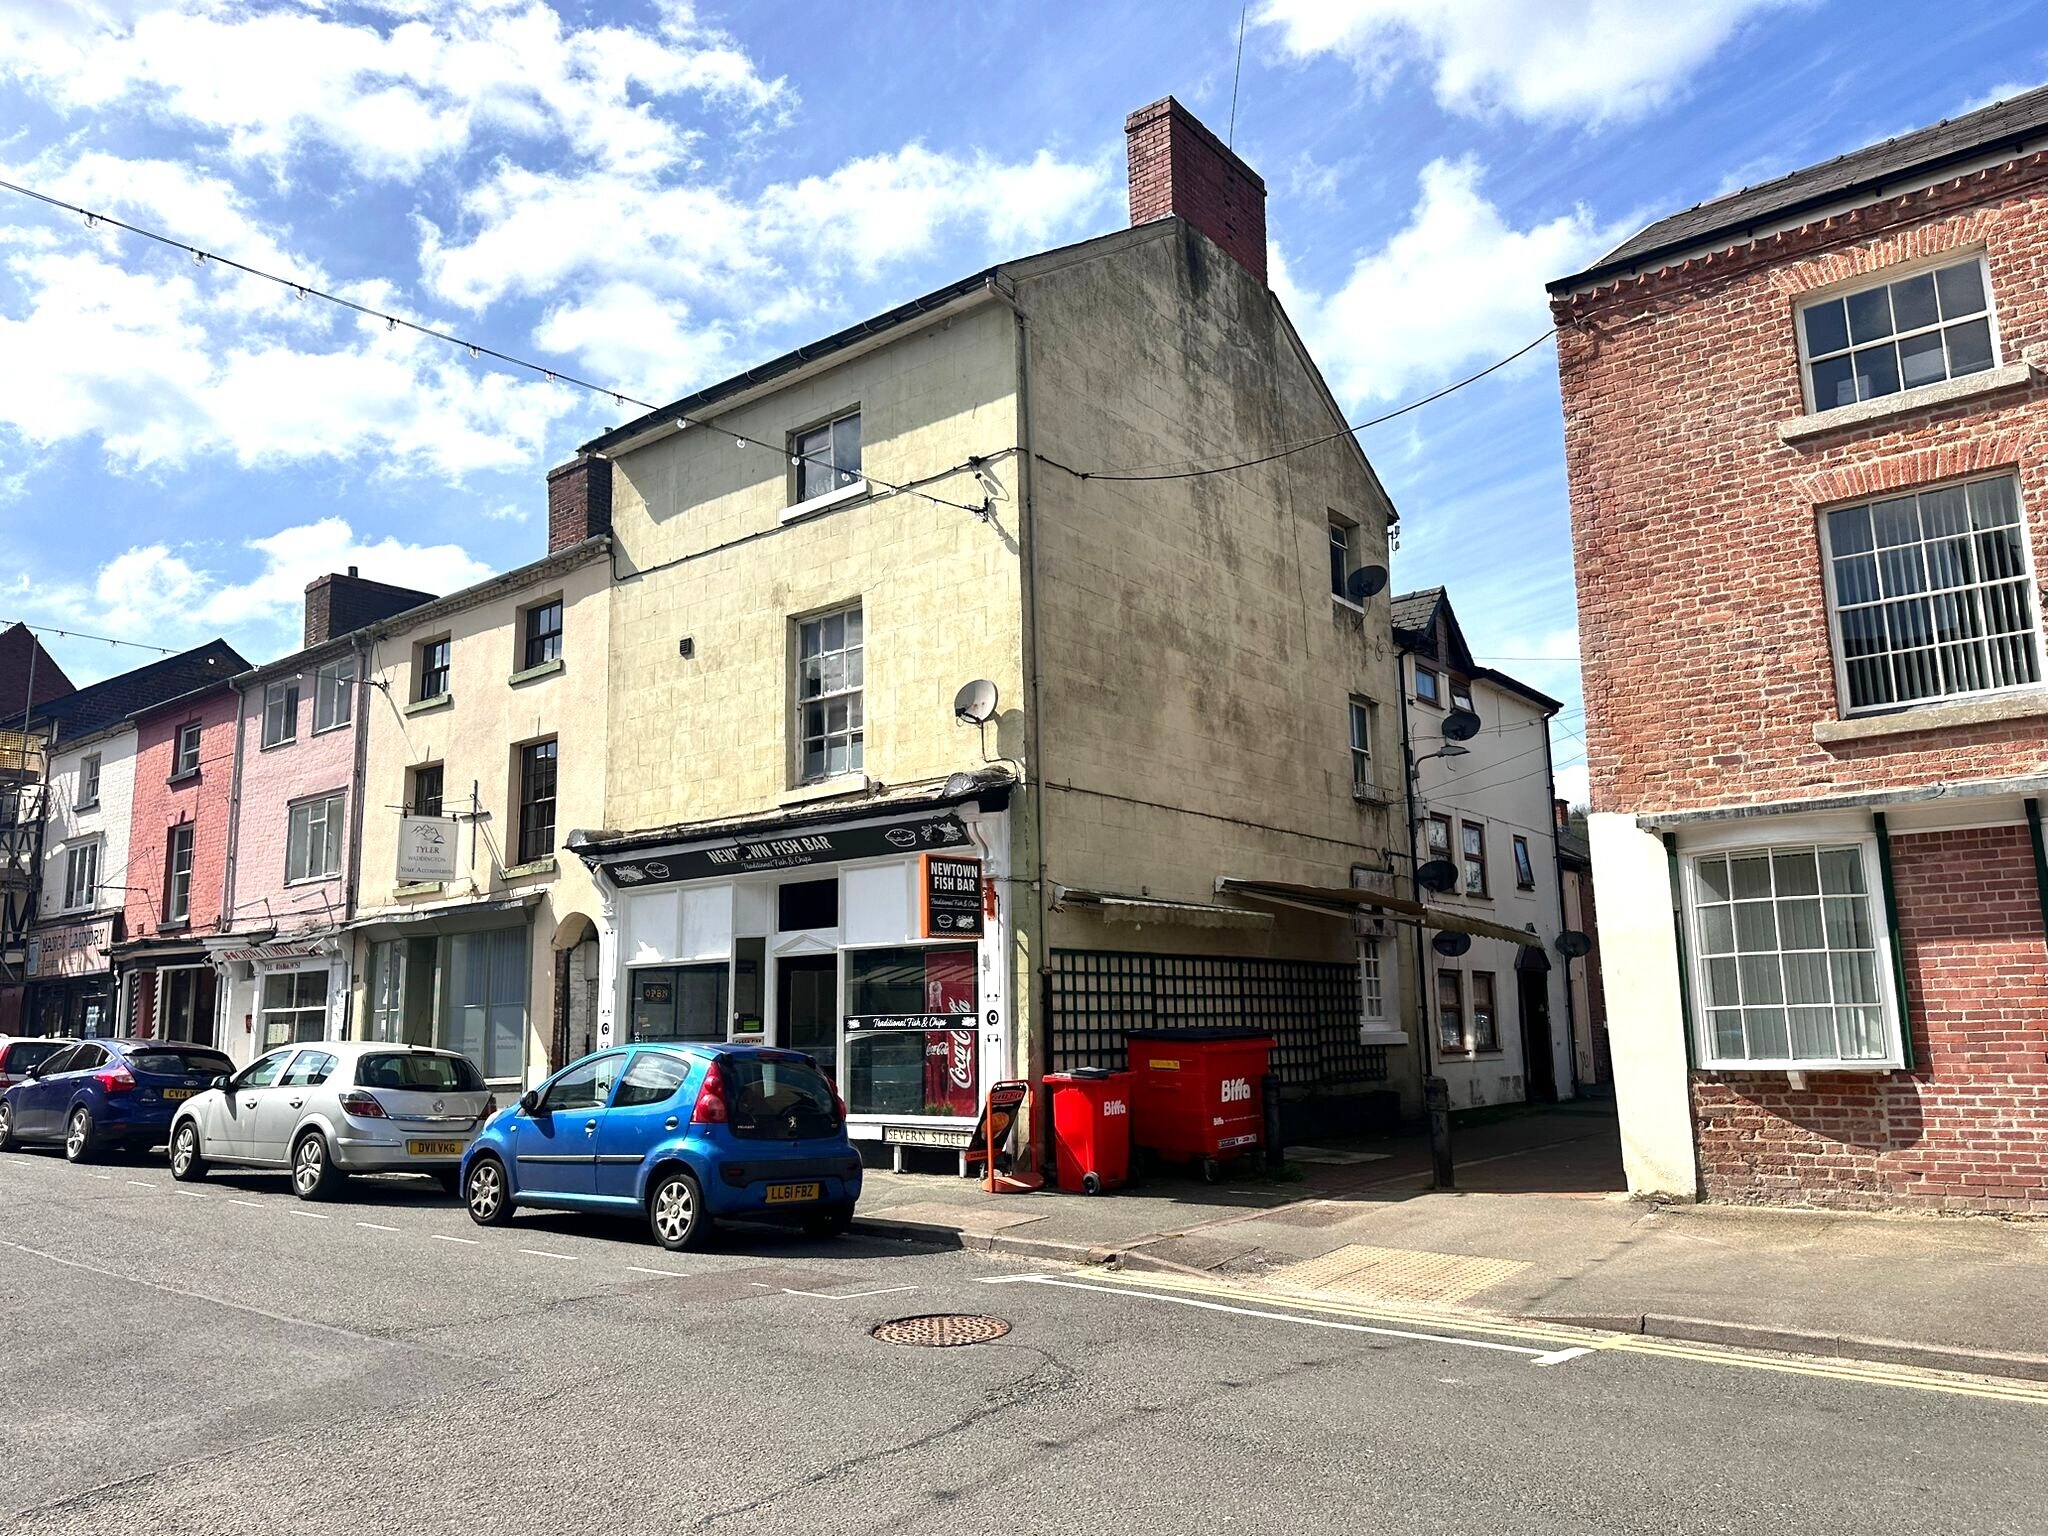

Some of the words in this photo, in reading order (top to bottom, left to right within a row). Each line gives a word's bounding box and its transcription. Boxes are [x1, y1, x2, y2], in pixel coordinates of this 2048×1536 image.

[415, 845, 440, 854] TYLER
[706, 843, 772, 864] NEWTWN
[770, 839, 803, 856] FISH
[800, 835, 833, 851] BAR
[741, 860, 772, 870] Traditional
[771, 858, 788, 868] Fish
[787, 856, 795, 866] &
[795, 855, 812, 864] Chips
[930, 862, 978, 878] NEWTOWN
[934, 876, 954, 890] FISH
[957, 879, 975, 891] BAR
[872, 1018, 907, 1028] Traditional
[906, 1018, 922, 1028] Fish
[920, 1016, 929, 1028] &
[929, 1016, 948, 1029] Chips
[168, 1089, 188, 1098] CV14
[1221, 1077, 1251, 1103] Biffa
[1103, 1099, 1126, 1116] Biffa
[888, 1128, 926, 1142] SEVERN
[932, 1131, 968, 1145] STREET
[437, 1143, 456, 1153] VKG
[771, 1186, 793, 1200] LL61
[795, 1184, 814, 1199] FBZ
